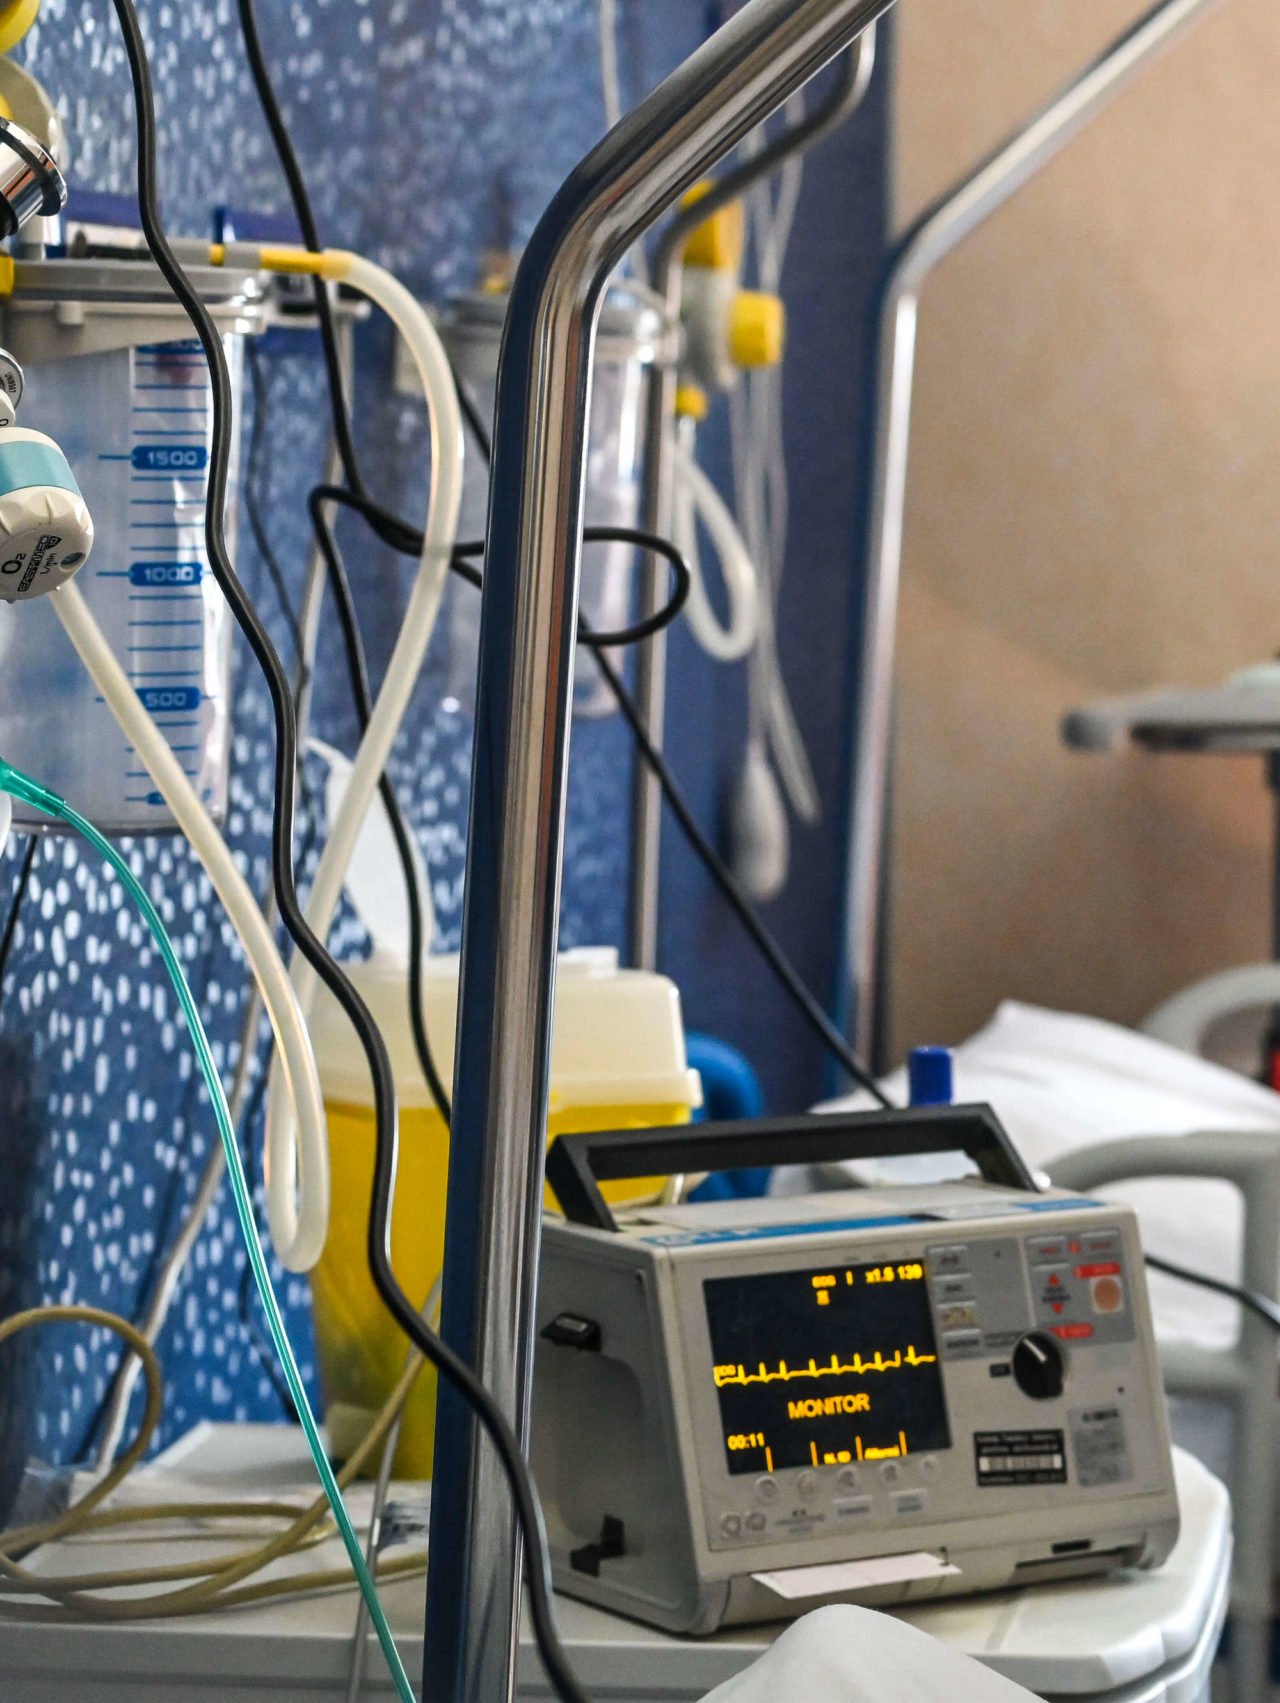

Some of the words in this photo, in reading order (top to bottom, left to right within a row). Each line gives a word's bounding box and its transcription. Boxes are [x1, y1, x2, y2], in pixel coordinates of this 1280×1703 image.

[147, 451, 198, 467] 1500
[144, 565, 195, 582] 1000
[145, 692, 187, 708] 500
[787, 1392, 871, 1420] MONITOR
[727, 1431, 765, 1450] 00:11
